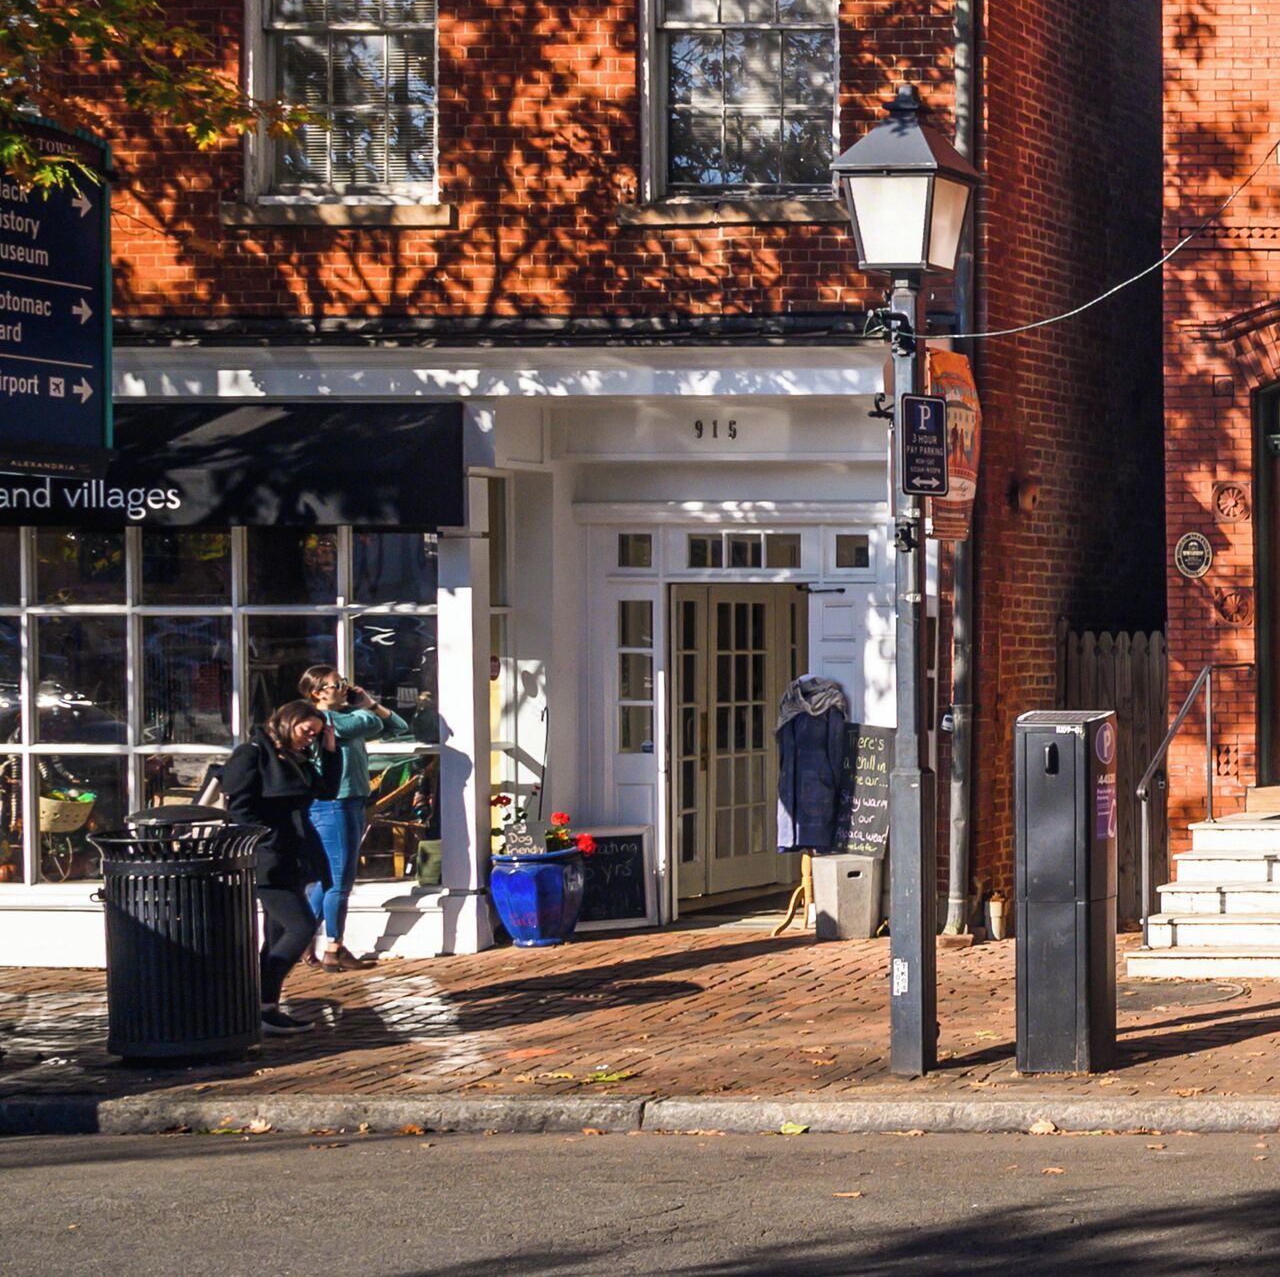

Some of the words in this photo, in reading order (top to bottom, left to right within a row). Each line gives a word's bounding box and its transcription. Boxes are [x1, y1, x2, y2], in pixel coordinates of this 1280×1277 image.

[0, 208, 40, 240] istory
[0, 242, 49, 266] useum
[0, 290, 52, 317] otomac
[0, 322, 22, 343] ard
[0, 369, 39, 396] irport
[918, 404, 931, 430] P
[694, 419, 737, 439] 915
[918, 435, 937, 444] HOUR
[906, 445, 918, 453] PAY
[919, 446, 943, 456] PARKING
[11, 460, 75, 471] ALEXANDRIA
[63, 478, 181, 520] villages
[862, 797, 888, 810] warm
[858, 815, 875, 824] our
[508, 832, 533, 845] Dog
